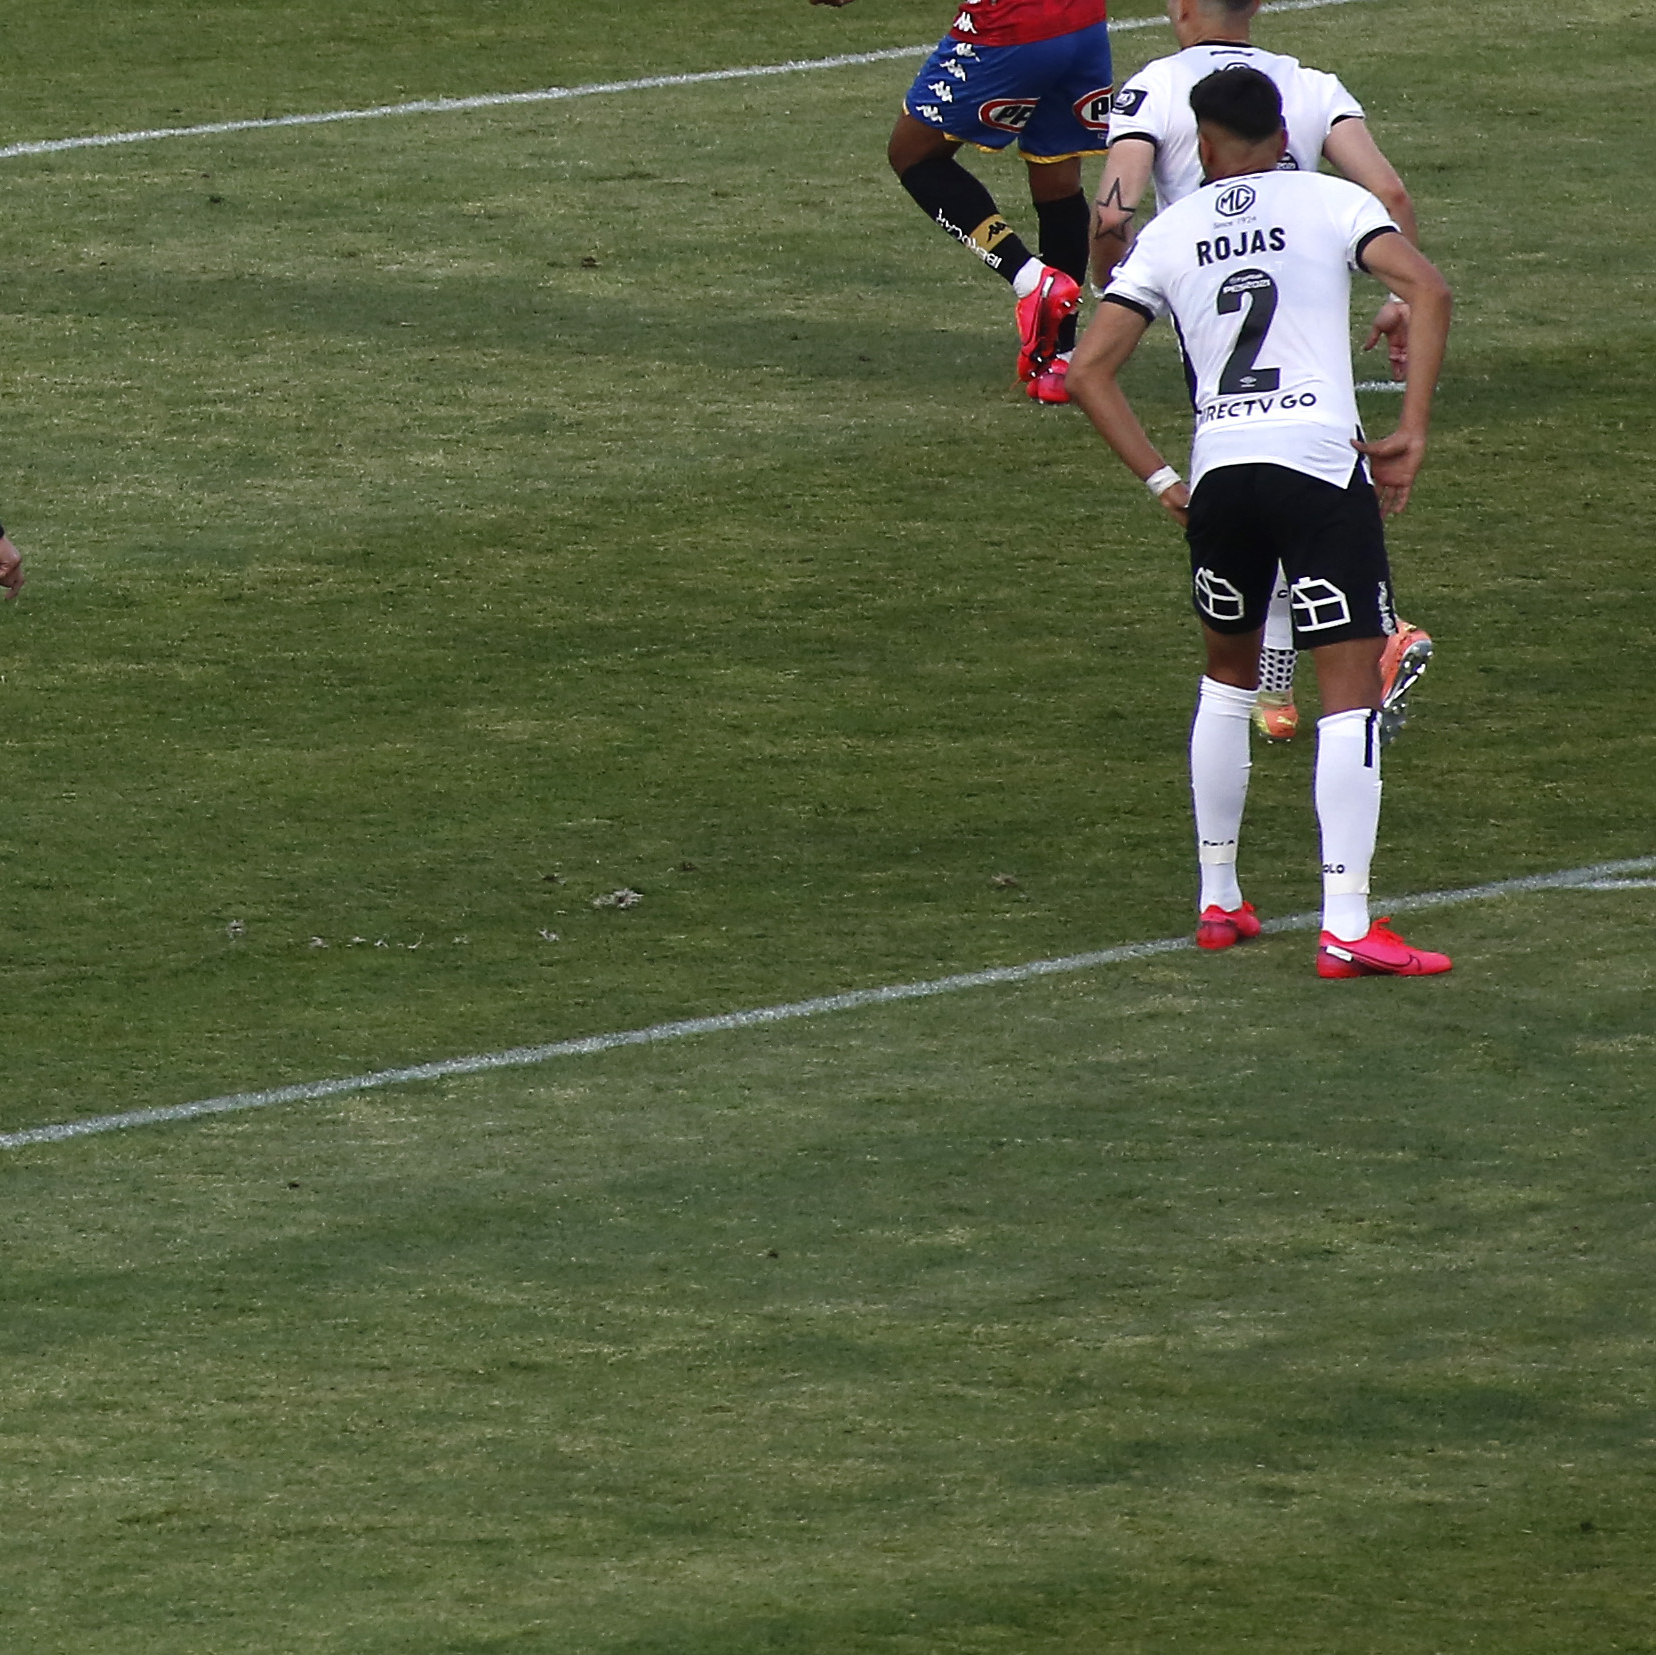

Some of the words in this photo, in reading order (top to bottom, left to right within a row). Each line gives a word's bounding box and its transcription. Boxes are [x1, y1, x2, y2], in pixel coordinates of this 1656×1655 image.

[994, 105, 1036, 125] PF
[1091, 95, 1114, 121] P
[1220, 187, 1251, 212] MG
[1195, 227, 1286, 267] ROJAS
[1216, 268, 1282, 395] 2
[1195, 398, 1274, 426] IRECTV
[1280, 392, 1317, 409] GO
